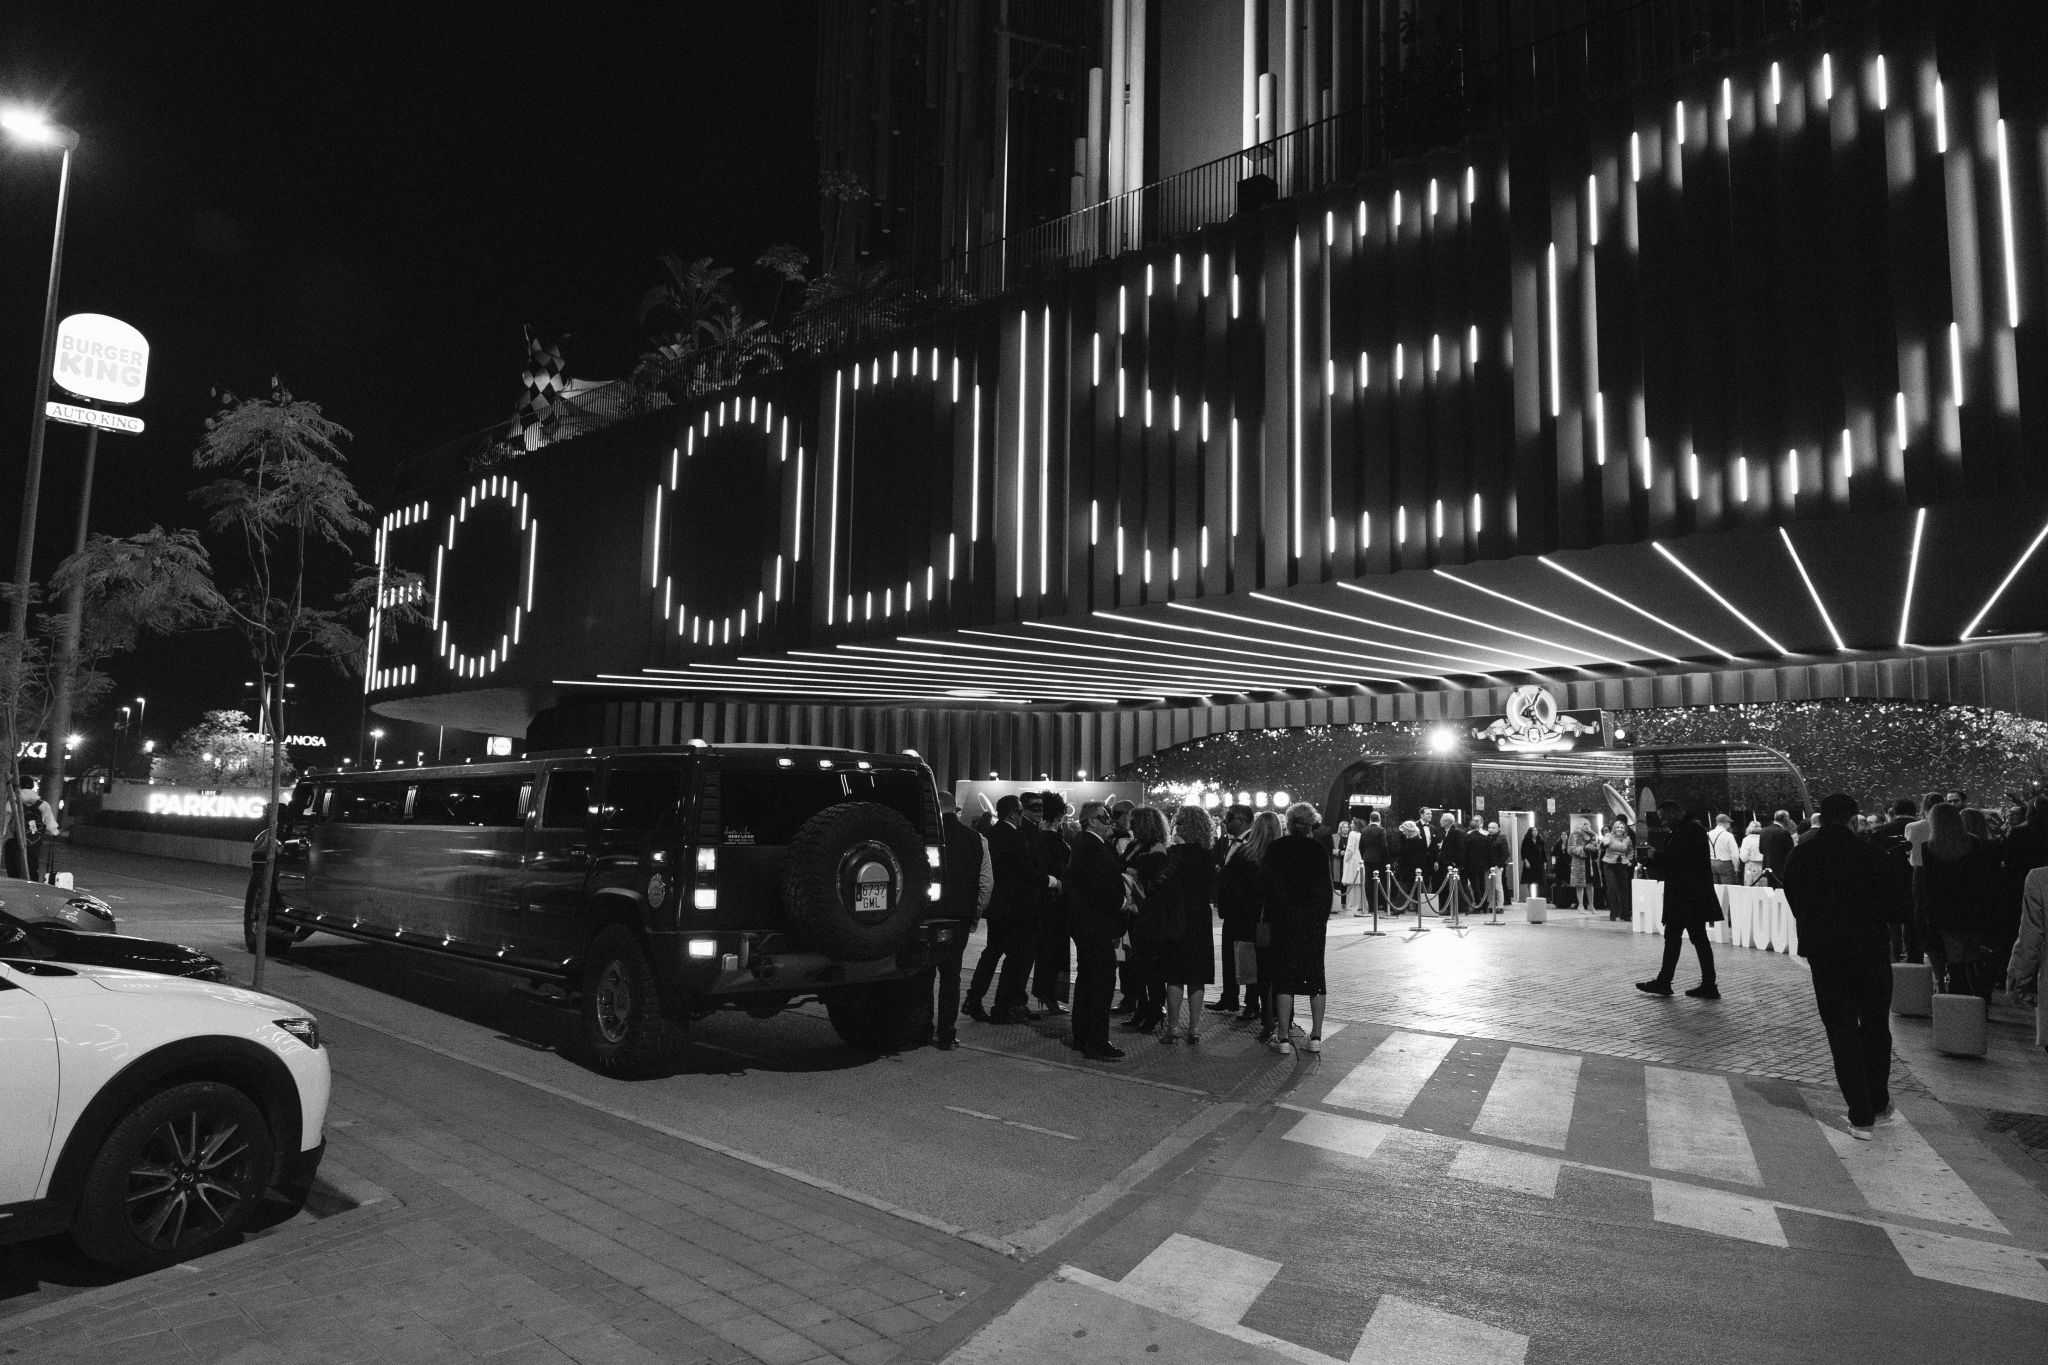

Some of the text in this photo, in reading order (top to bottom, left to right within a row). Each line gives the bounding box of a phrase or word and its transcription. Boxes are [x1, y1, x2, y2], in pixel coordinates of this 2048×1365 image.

[62, 334, 143, 367] BURGER
[651, 53, 2018, 646] ODISEO
[59, 350, 141, 388] KING
[52, 405, 138, 431] AUTO KING
[239, 732, 326, 747] PORCANOSA
[148, 793, 267, 819] PARKING
[862, 884, 886, 897] 6737
